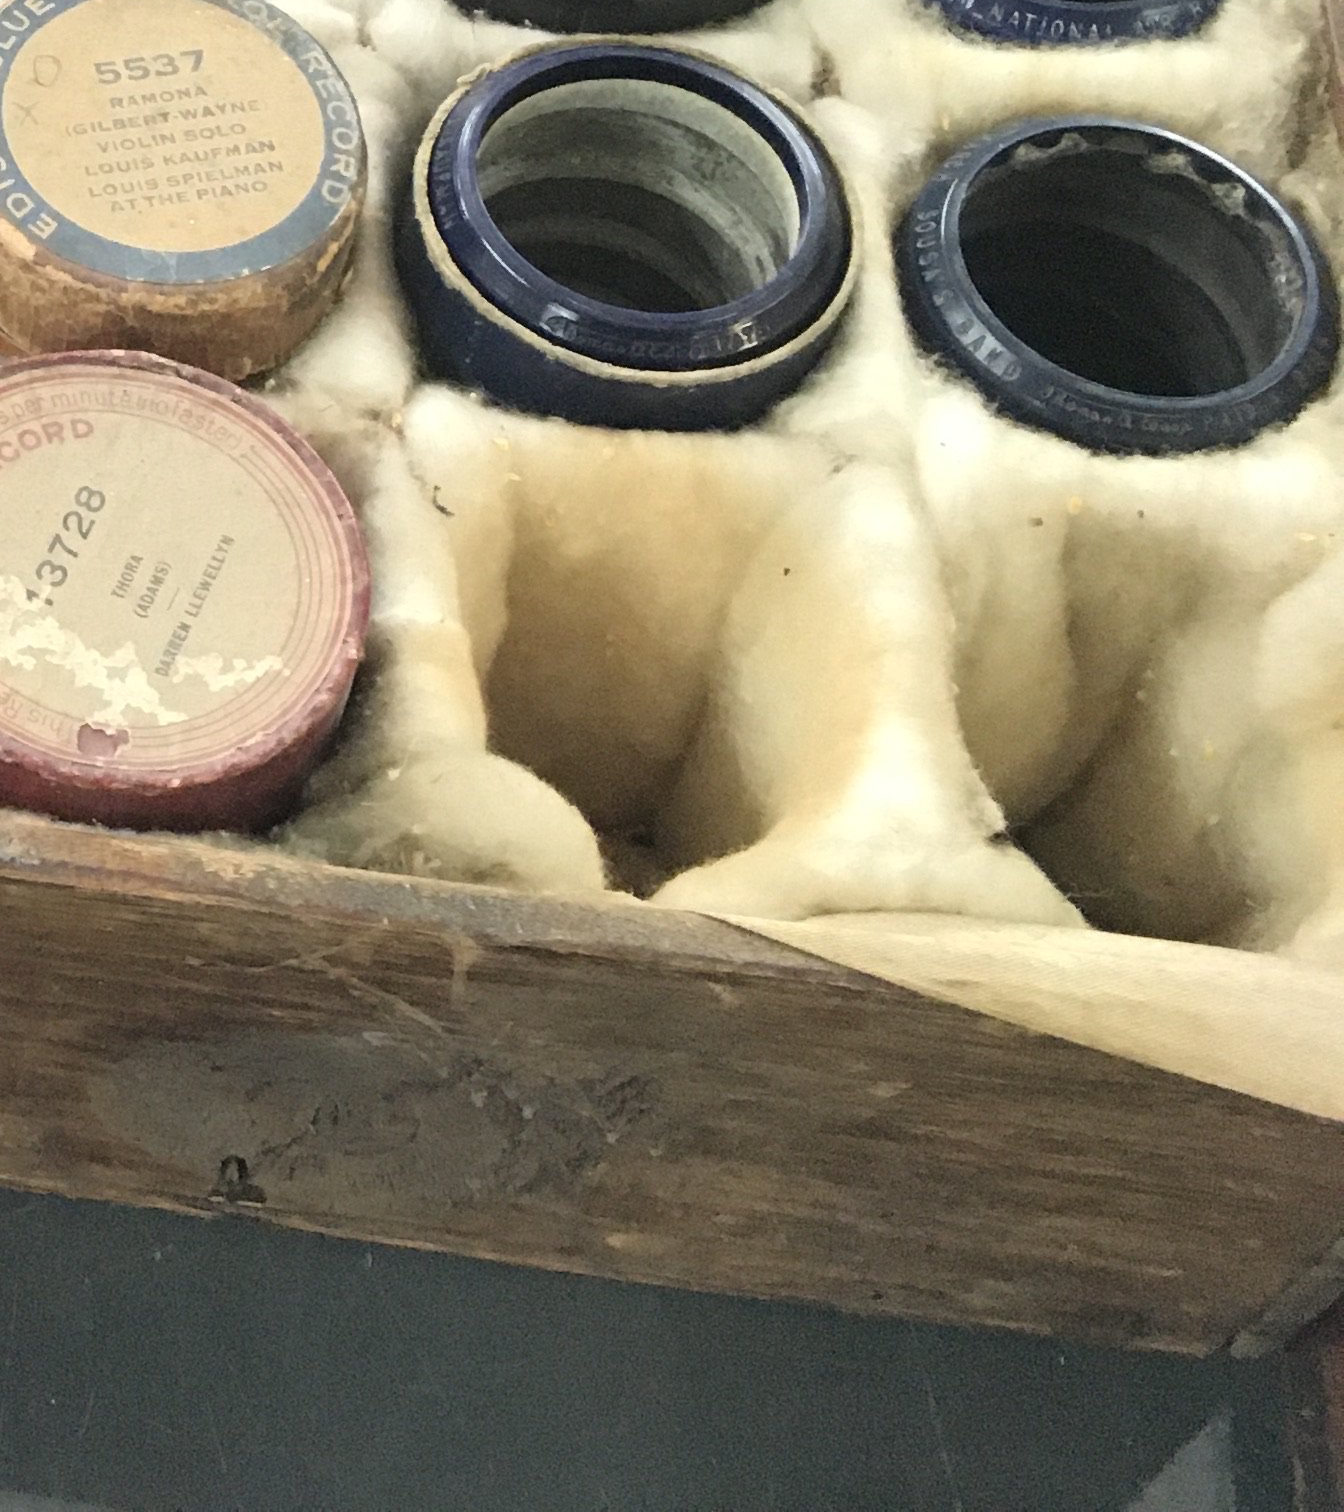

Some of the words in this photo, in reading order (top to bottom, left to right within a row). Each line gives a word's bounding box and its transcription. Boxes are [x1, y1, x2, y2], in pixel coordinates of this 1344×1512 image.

[94, 49, 207, 85] 5537
[110, 86, 209, 110] RAMONA
[97, 132, 177, 154] VIOLIN
[183, 122, 248, 141] SOLO
[301, 50, 360, 206] RECORD
[85, 156, 156, 177] LOUIS
[163, 139, 277, 168] KAUFMAN
[88, 177, 159, 198] LOUIS
[166, 160, 285, 188] SPIELMAN
[111, 197, 140, 214] AT
[143, 192, 191, 210] THE
[196, 180, 268, 202] PIANO
[11, 395, 46, 421] per
[111, 553, 145, 601] THORA
[133, 561, 173, 621] (ADAMS)
[154, 616, 191, 677] DARREN
[186, 534, 236, 620] LLEWELLYN
